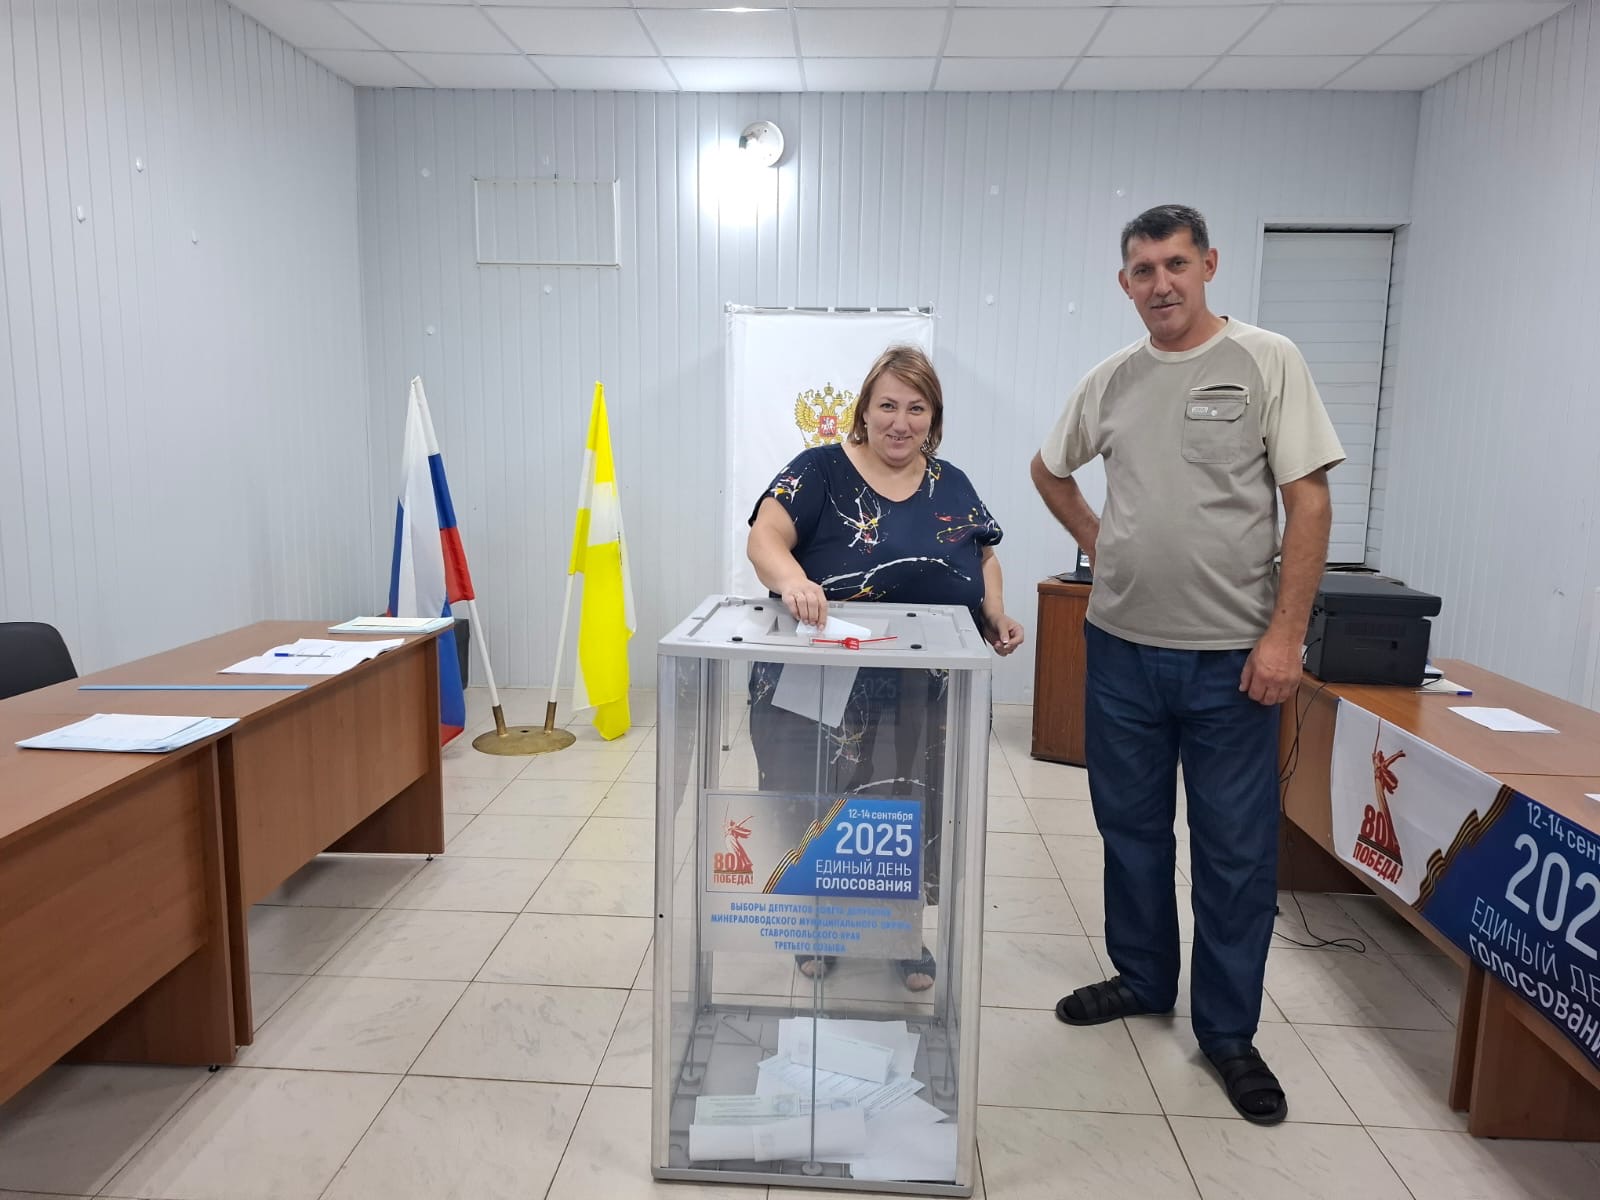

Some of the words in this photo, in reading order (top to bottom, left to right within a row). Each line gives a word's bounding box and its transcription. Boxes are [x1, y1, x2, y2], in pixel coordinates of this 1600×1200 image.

[848, 808, 871, 819] 12-14
[871, 811, 914, 822] сентября
[1527, 802, 1565, 842] 12-14
[1360, 804, 1388, 848] 80
[835, 821, 913, 857] 2025
[713, 852, 737, 870] 80
[815, 858, 872, 875] ЕДИНЫЙ
[876, 862, 912, 877] ДЕНЬ
[1353, 841, 1404, 884] ПОБЕДА!
[713, 874, 754, 886] ПОБЕДА!
[815, 877, 912, 892] голосования
[1505, 833, 1600, 961] 202
[731, 902, 766, 911] ВЫБОРЫ
[769, 903, 813, 913] ДЕПУТАТОВ
[711, 914, 797, 925] МИНЕРАЛОВОДСКОГО
[760, 928, 838, 939] СТАВРОПОЛЬСКОГО
[1471, 896, 1559, 981] ЕДИНЫЙ
[775, 941, 810, 951] ТРЕТЬЕГО
